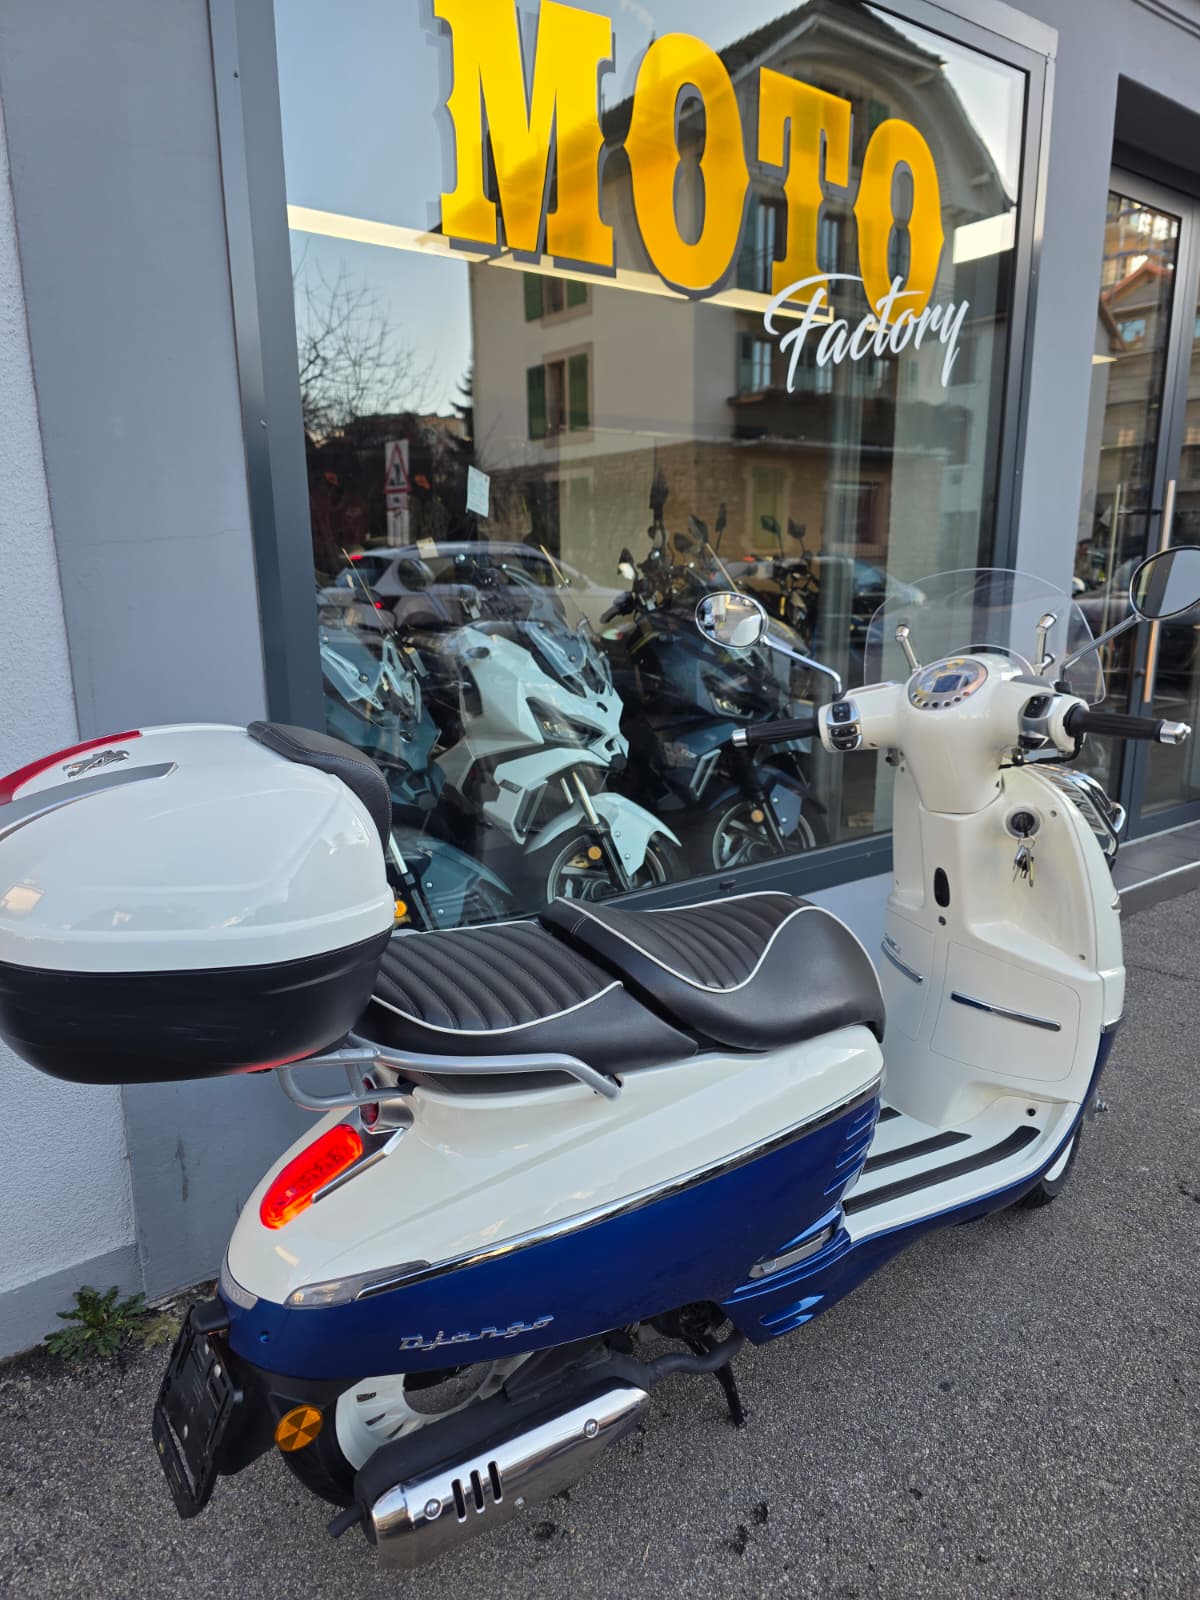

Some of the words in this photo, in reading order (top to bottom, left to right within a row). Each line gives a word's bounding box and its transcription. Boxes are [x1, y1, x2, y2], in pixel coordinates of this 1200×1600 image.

[434, 0, 945, 328] MOTO
[764, 273, 969, 393] Factory
[399, 1314, 555, 1351] Django
